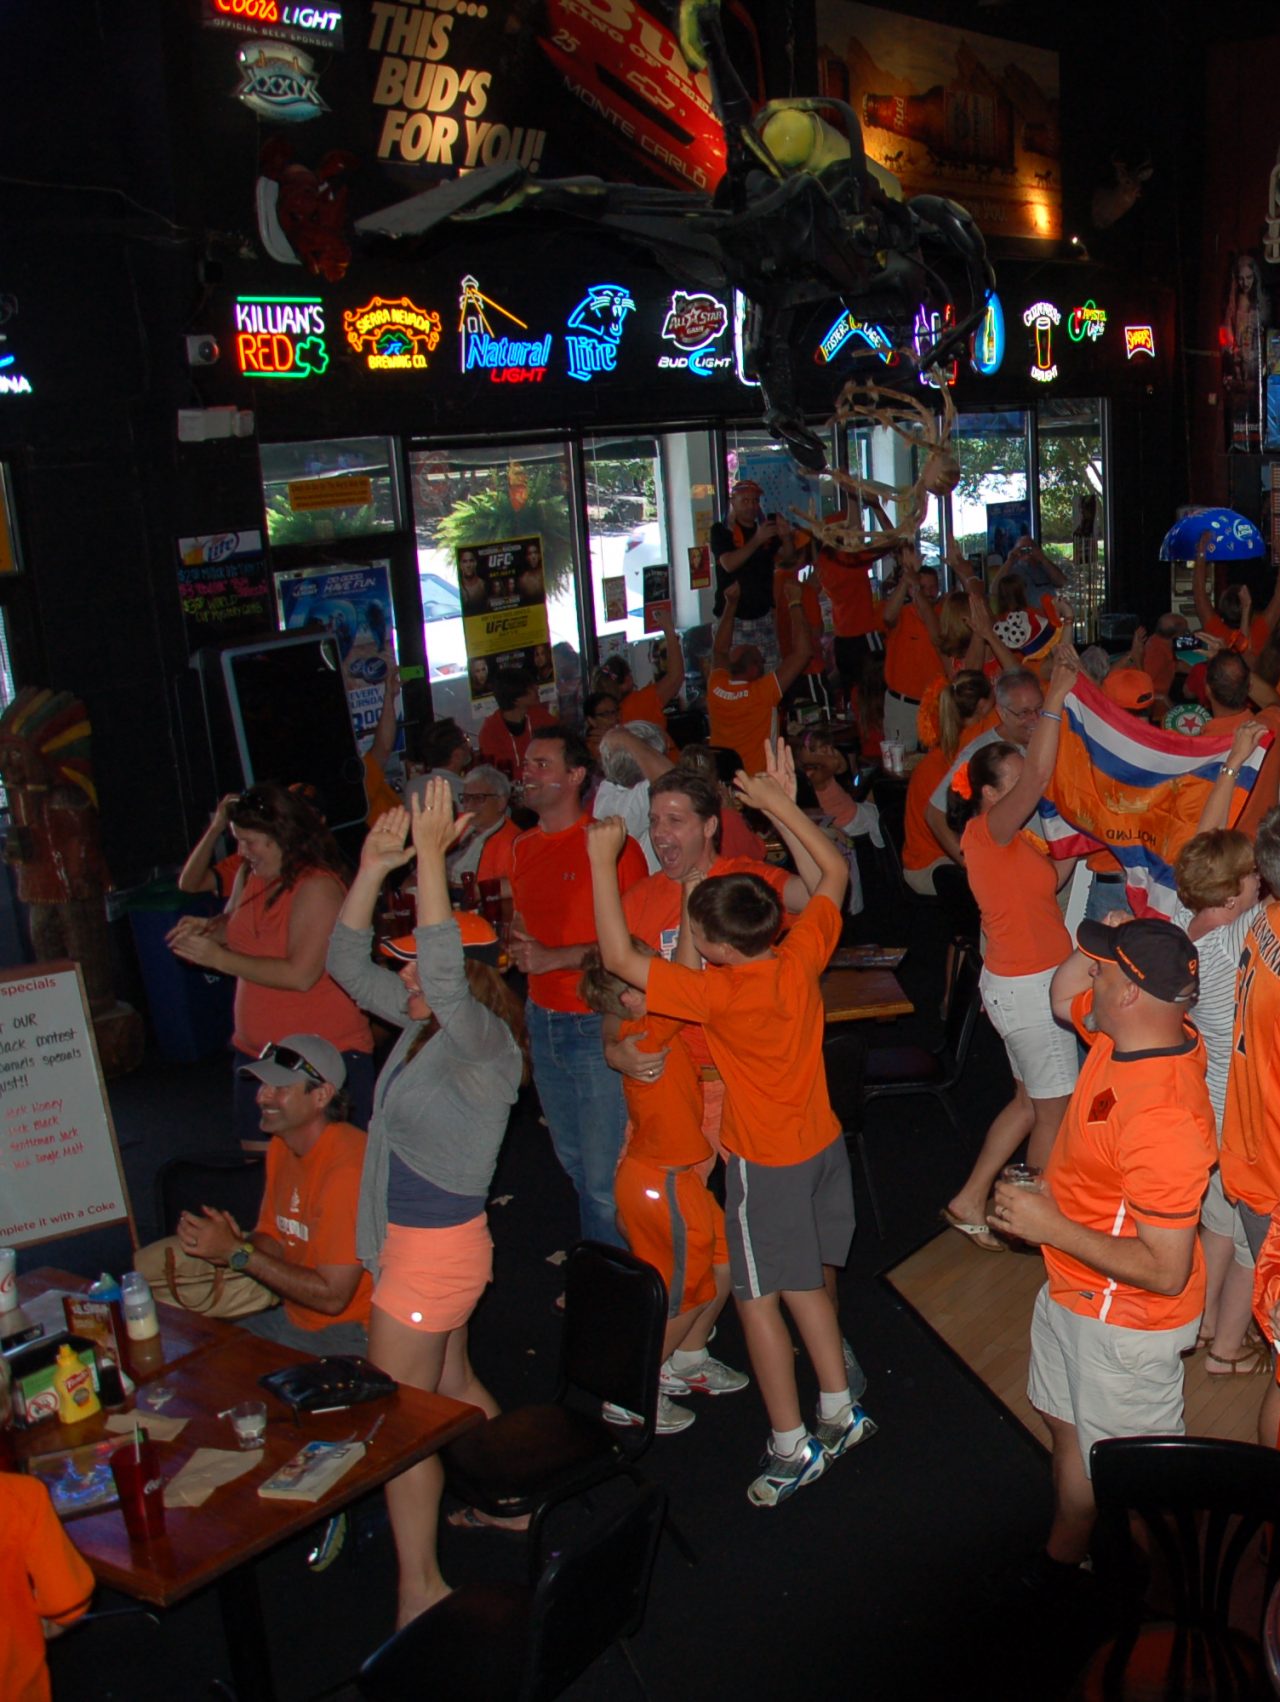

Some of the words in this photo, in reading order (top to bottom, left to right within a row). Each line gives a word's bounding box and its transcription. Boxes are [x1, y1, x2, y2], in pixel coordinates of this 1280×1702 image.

[282, 6, 342, 31] LIGHT
[368, 1, 455, 61] THIS
[551, 28, 581, 53] 25
[247, 69, 320, 103] XXXIX
[372, 57, 493, 119] BUD'S
[377, 110, 459, 166] FOR
[464, 119, 547, 174] YOU!
[561, 75, 637, 139] MONTE
[640, 136, 708, 190] CARLO
[237, 303, 326, 336] KILLIAN'S
[356, 309, 391, 334] SIERRA
[391, 309, 430, 334] NEVADA
[669, 315, 687, 330] ALL
[698, 311, 722, 325] STAR
[1023, 301, 1062, 327] GUINNESS
[238, 335, 294, 371] RED
[368, 354, 412, 369] BREWING
[467, 334, 552, 370] Natural
[565, 335, 618, 382] Lite
[658, 356, 688, 368] BUD
[694, 357, 732, 368] LIGHT
[490, 367, 551, 384] LIGHT
[489, 552, 513, 568] UFC
[353, 577, 377, 590] FUN
[486, 619, 509, 634] UFC
[0, 978, 57, 996] specials
[13, 1013, 38, 1029] OUR
[39, 1216, 47, 1227] it
[50, 1210, 75, 1224] with
[78, 1209, 84, 1217] a
[87, 1201, 115, 1214] Coke
